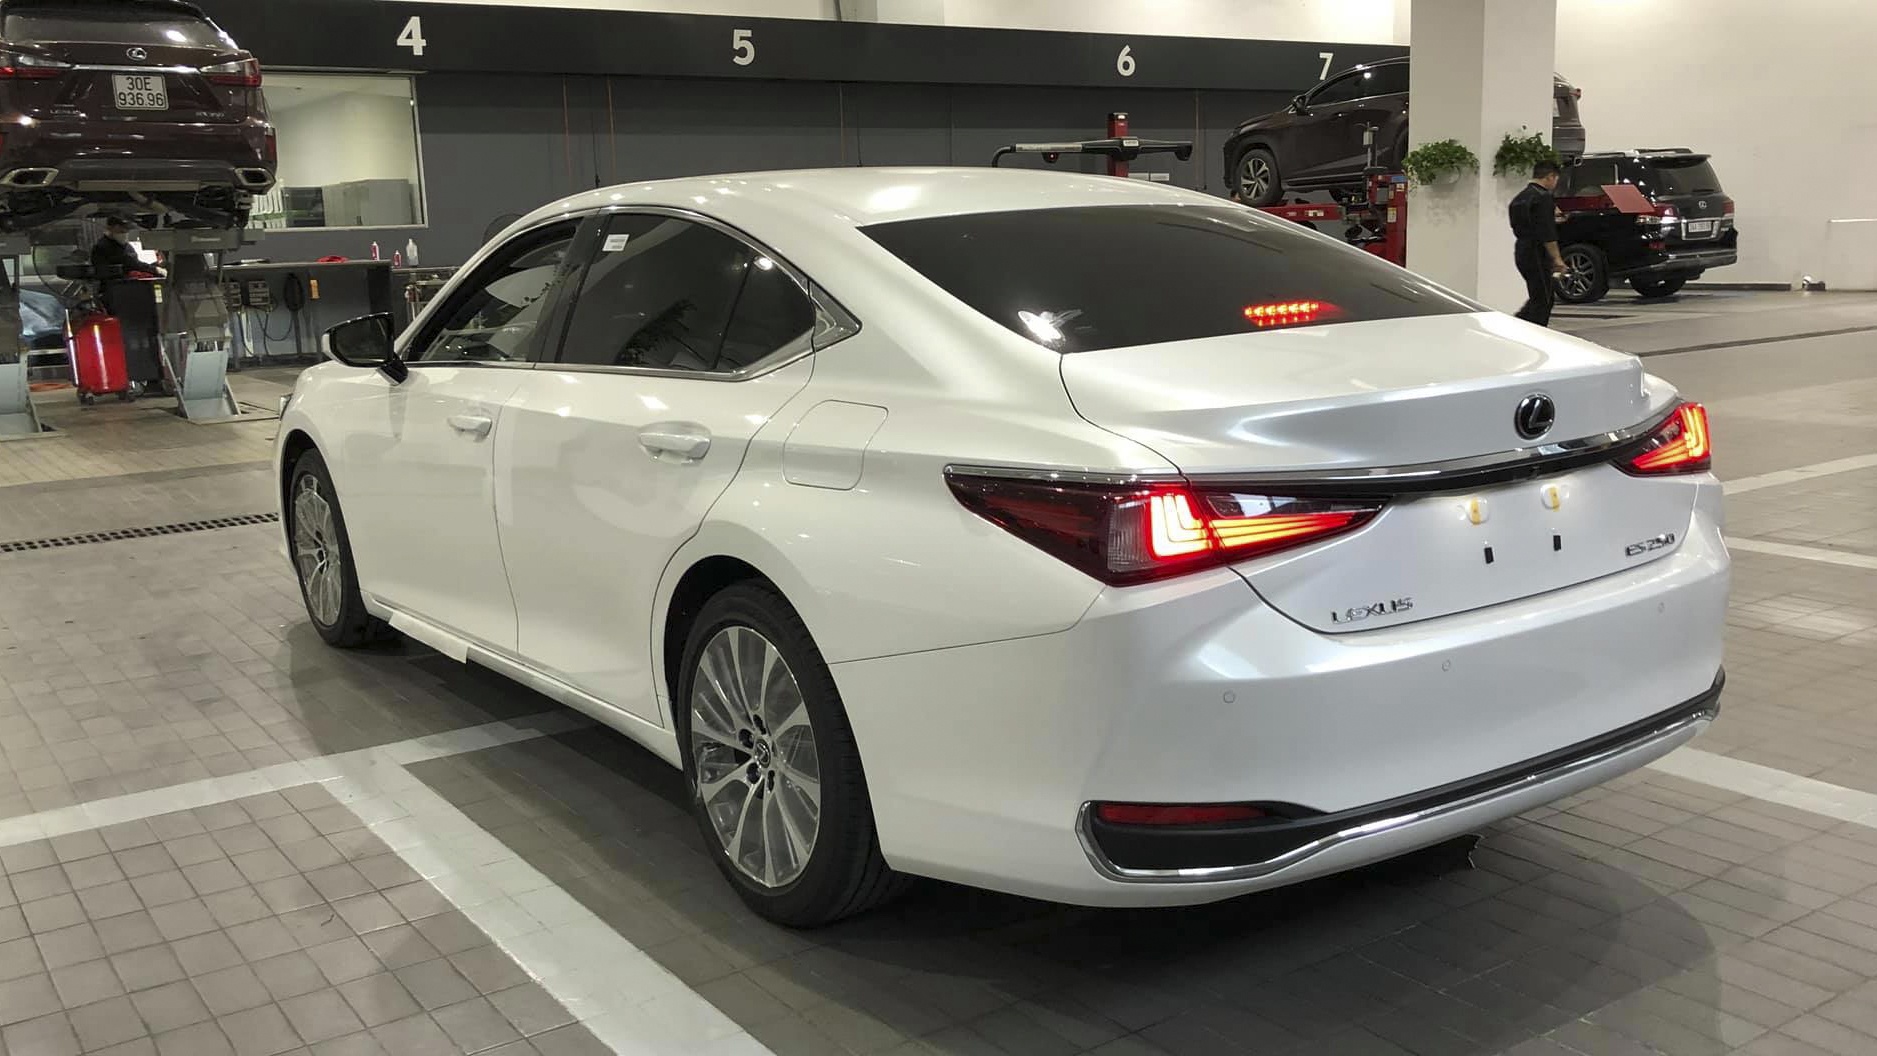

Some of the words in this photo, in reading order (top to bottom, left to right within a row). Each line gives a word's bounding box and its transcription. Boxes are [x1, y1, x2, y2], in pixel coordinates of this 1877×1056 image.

[396, 16, 427, 56] 4
[732, 29, 755, 66] 5
[1116, 44, 1136, 77] 6
[1318, 52, 1334, 81] 7
[126, 76, 153, 91] 30E
[1625, 541, 1646, 557] ES
[1330, 596, 1414, 624] LEXUS
